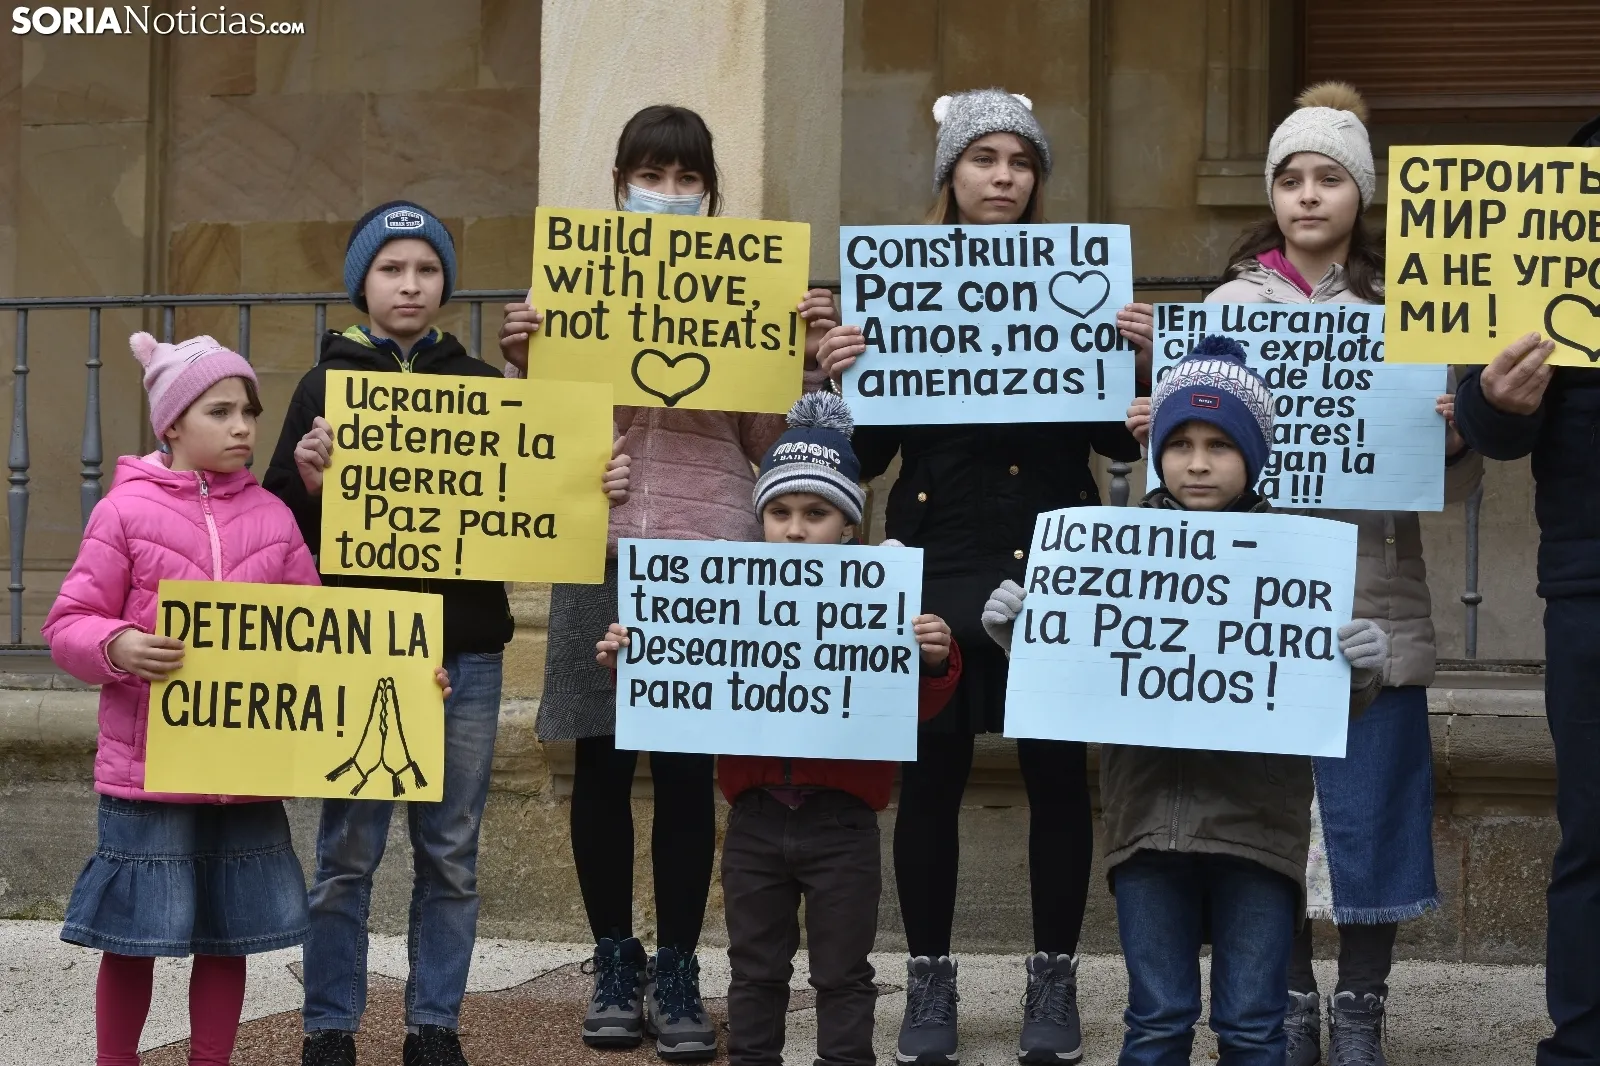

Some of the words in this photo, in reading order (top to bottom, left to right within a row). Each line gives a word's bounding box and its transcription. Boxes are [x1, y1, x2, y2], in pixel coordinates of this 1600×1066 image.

[1400, 157, 1600, 194] СТРОИТЬ
[548, 216, 652, 256] Build
[1400, 199, 1506, 239] МИР
[1070, 226, 1108, 266] la
[543, 255, 644, 299] with
[1397, 253, 1428, 285] А
[1444, 253, 1492, 286] НЕ
[856, 273, 943, 312] Paz
[958, 280, 1038, 313] con
[545, 300, 610, 340] not
[1267, 366, 1307, 390] de
[1322, 363, 1374, 390] los
[517, 422, 555, 460] la
[773, 442, 841, 464] MAGIC
[1341, 447, 1375, 474] la
[364, 495, 441, 533] Paz
[629, 544, 689, 584] Las
[700, 555, 824, 587] armas
[840, 559, 885, 589] no
[758, 590, 800, 627] la
[1024, 609, 1070, 644] la
[1094, 603, 1189, 653] Paz
[388, 611, 429, 659] LA
[625, 626, 801, 670] Deseamos
